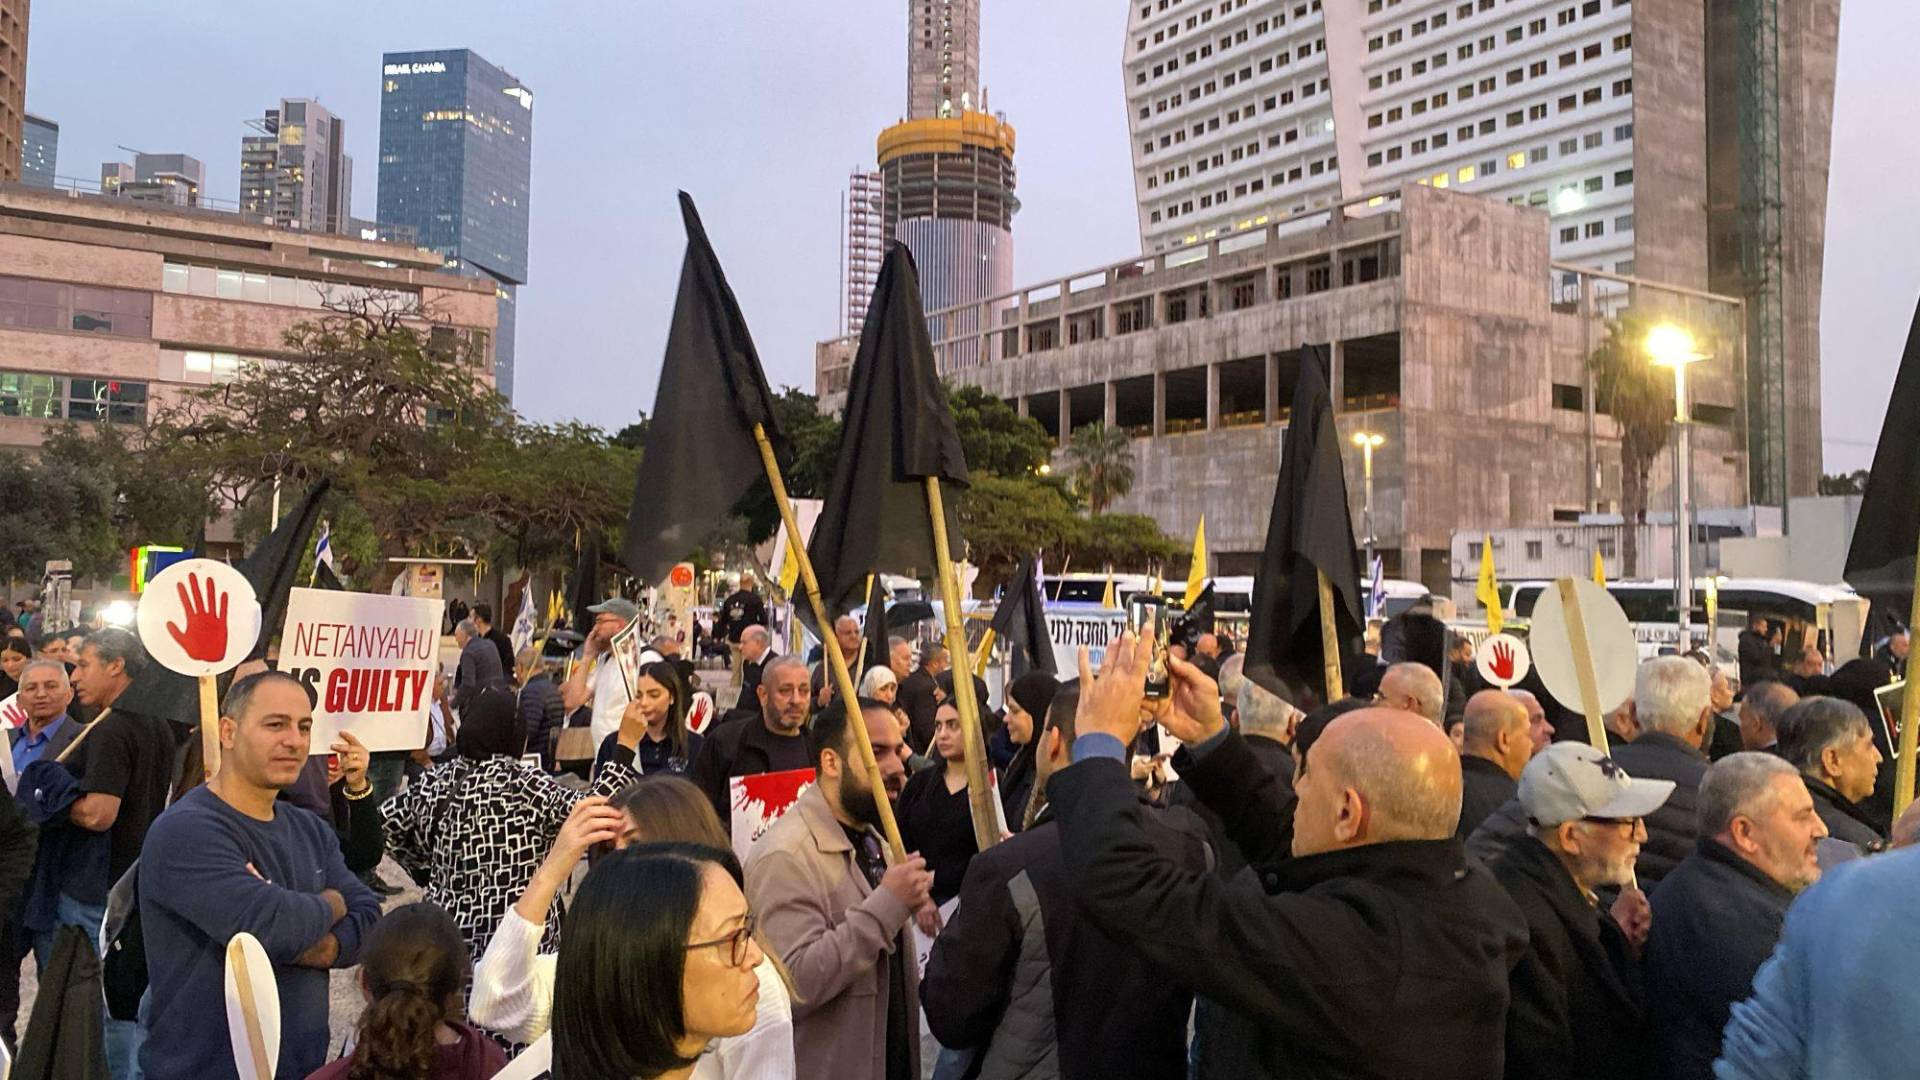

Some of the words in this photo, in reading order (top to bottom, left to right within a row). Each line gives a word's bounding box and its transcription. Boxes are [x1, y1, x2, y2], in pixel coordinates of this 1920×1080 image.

[293, 622, 434, 660] NETANYAHU
[290, 667, 321, 713] S
[325, 667, 429, 713] GUILTY
